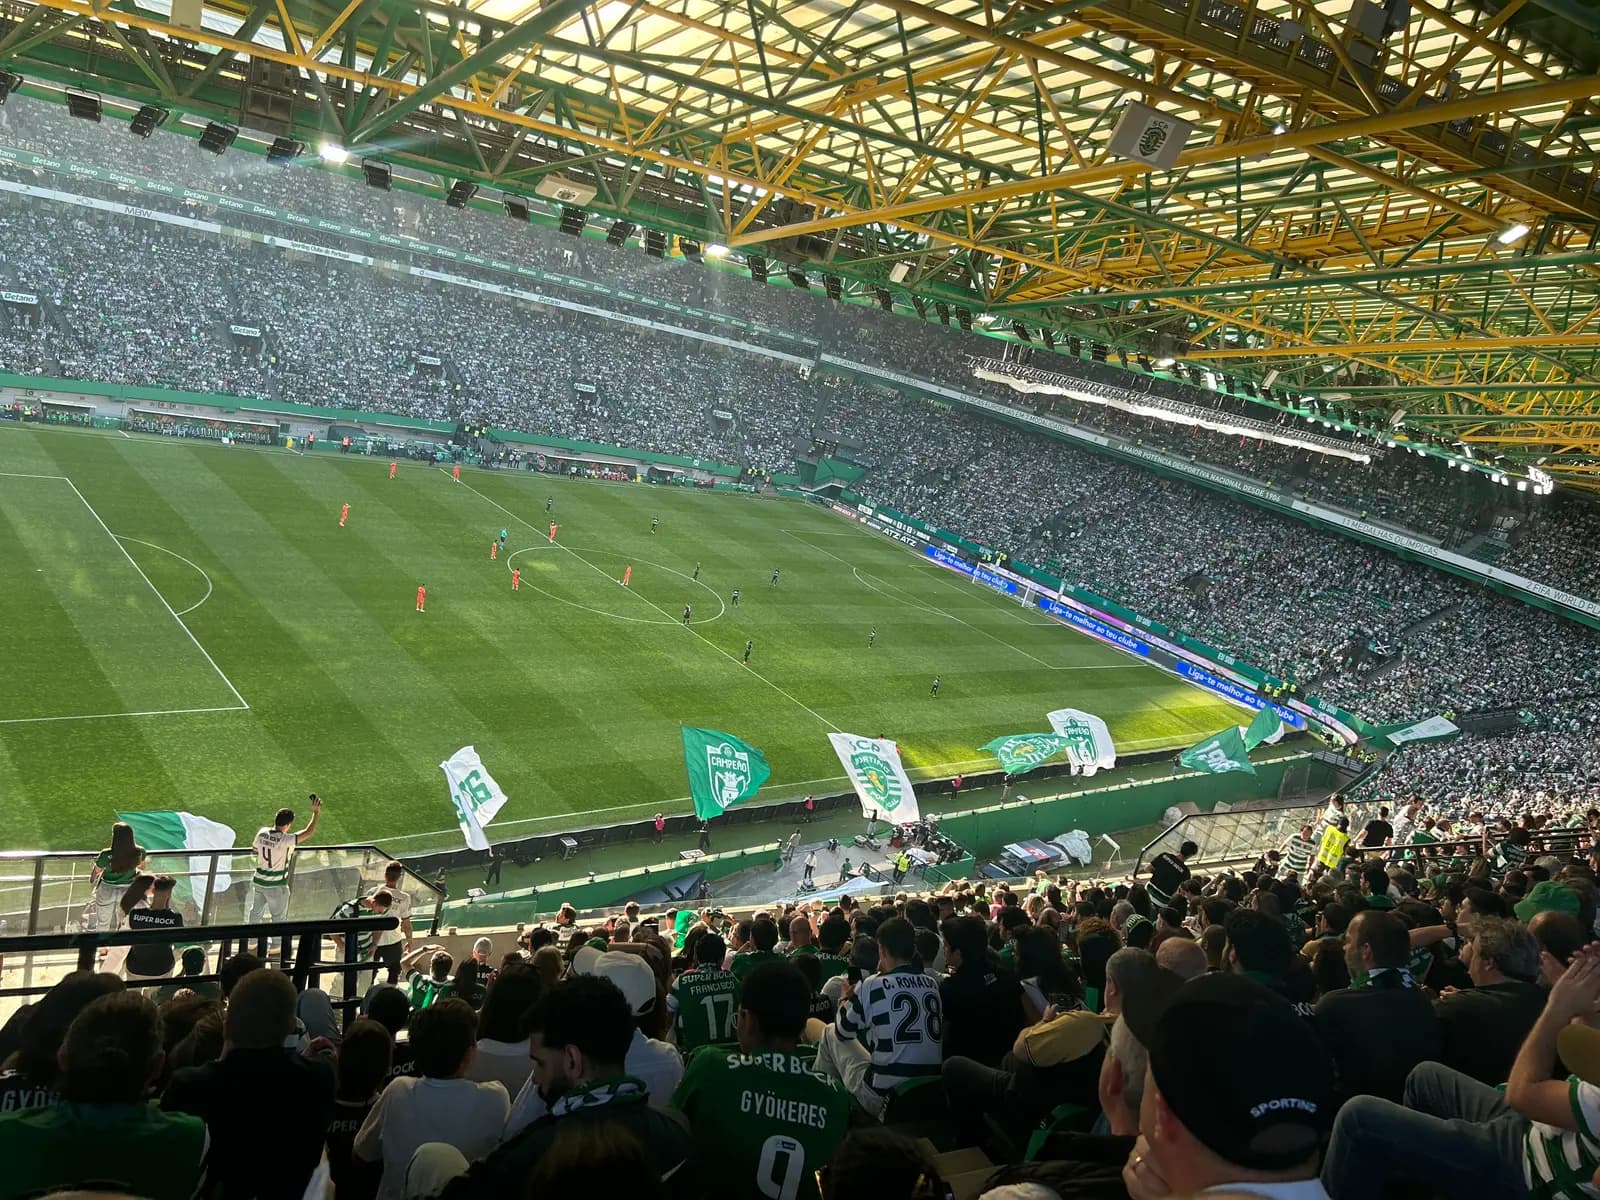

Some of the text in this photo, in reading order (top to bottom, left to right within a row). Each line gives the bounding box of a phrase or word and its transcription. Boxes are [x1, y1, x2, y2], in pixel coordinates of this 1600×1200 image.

[0, 149, 17, 159] tano
[33, 156, 61, 168] Betano
[70, 164, 98, 176] Betano
[109, 173, 137, 185] Betano
[147, 181, 173, 193] Betano
[184, 189, 209, 201] Betano
[219, 198, 244, 209] Betano
[124, 206, 153, 218] MBW
[253, 205, 277, 217] Betano
[287, 213, 310, 224] Betano
[4, 292, 34, 303] Betano
[233, 326, 258, 336] Betano
[1123, 446, 1143, 457] MAIOR
[1172, 460, 1210, 479] DESPORTIVA
[1209, 472, 1242, 490] NACIONAL
[1243, 484, 1265, 497] DESDE
[1351, 520, 1393, 540] MEDALHAS
[882, 527, 901, 539] ATZ
[899, 535, 918, 547] ATZ
[934, 549, 954, 564] Liga-te
[954, 556, 973, 572] melhor
[1526, 581, 1533, 590] 2
[1532, 583, 1551, 597] FIFA
[1553, 591, 1586, 609] WORLD
[1049, 602, 1073, 619] Liga-te
[1072, 612, 1097, 630] melhor
[1096, 625, 1105, 634] ao
[1106, 629, 1118, 640] teu
[1117, 634, 1138, 649] clube
[1225, 655, 1235, 665] SOU
[1187, 666, 1216, 687] Liga-te
[1216, 679, 1245, 699] melhor
[1244, 694, 1255, 704] ao
[1256, 697, 1266, 709] te
[262, 846, 273, 869] 4
[133, 914, 175, 925] SUPER BOCK
[682, 973, 711, 985] SUPER
[882, 978, 895, 990] C.
[699, 992, 734, 1041] 17
[891, 990, 942, 1045] 28
[726, 1053, 786, 1073] SUPER
[740, 1089, 828, 1129] GYÖKERES
[1248, 1097, 1317, 1118] SPORTING
[756, 1134, 806, 1200] 9
